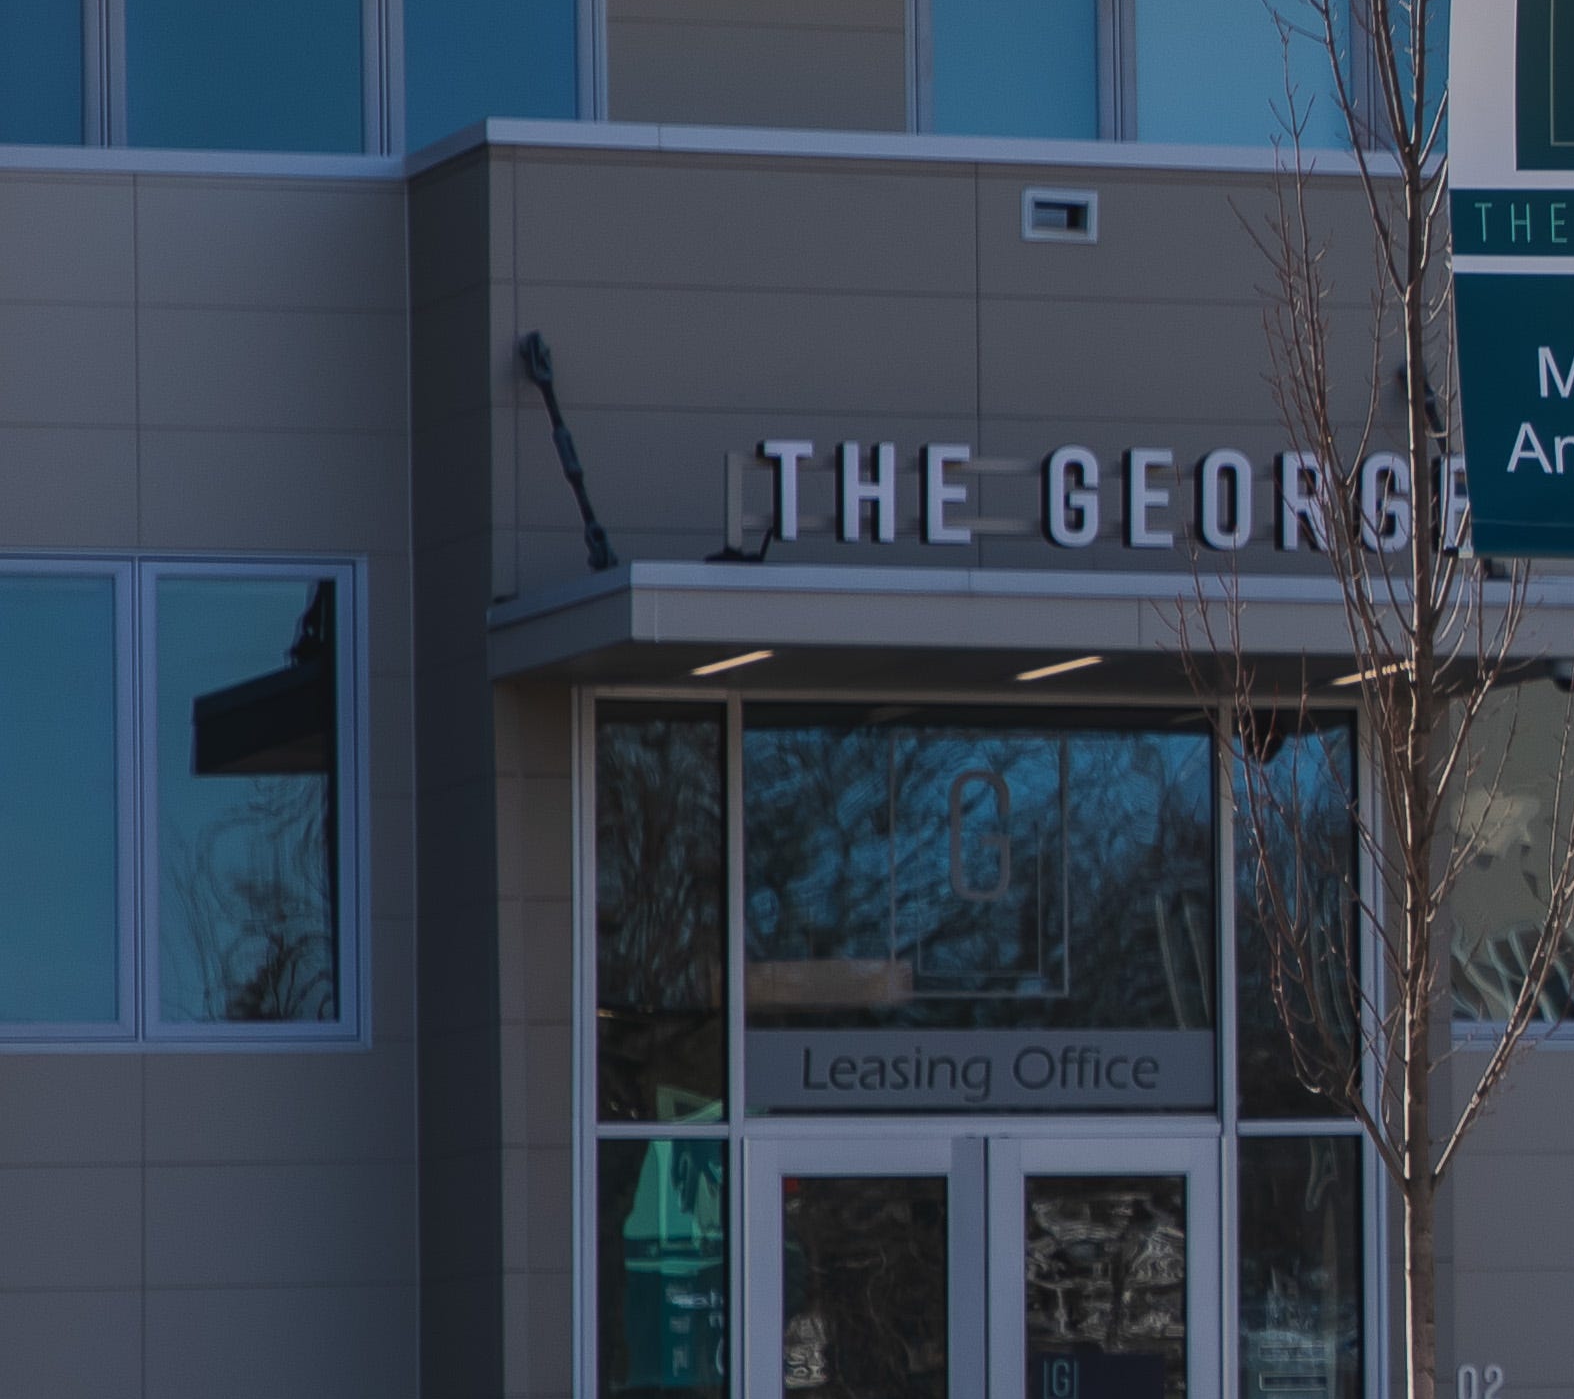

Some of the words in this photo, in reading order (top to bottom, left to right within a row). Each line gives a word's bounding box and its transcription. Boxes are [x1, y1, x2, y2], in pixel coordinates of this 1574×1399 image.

[1474, 202, 1568, 244] THE
[762, 439, 972, 544] THE
[802, 1045, 992, 1103] Leasing
[1012, 1044, 1160, 1091] Office
[1052, 1358, 1070, 1397] G
